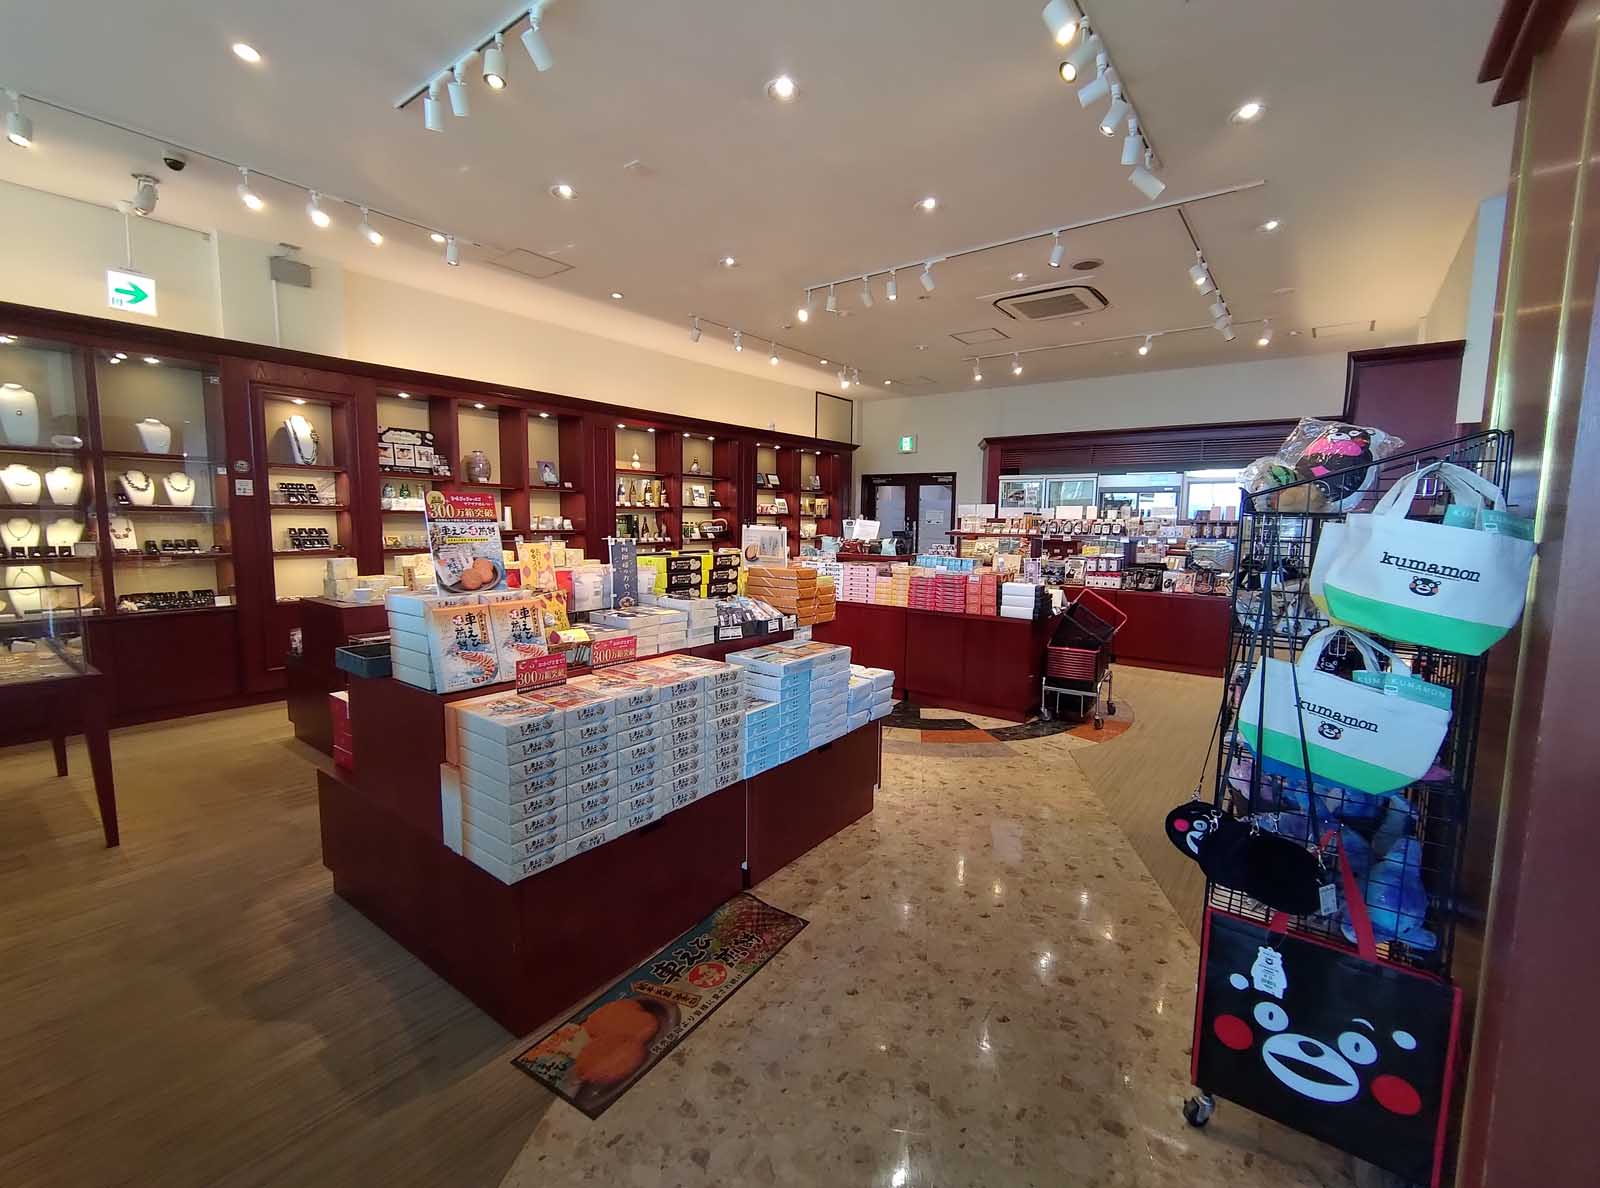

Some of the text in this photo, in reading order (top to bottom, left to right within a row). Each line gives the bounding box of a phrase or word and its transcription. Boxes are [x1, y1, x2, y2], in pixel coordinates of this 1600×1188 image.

[430, 504, 494, 518] 300万箱突破
[1380, 552, 1481, 582] kumamon
[464, 612, 481, 647] 車えび
[519, 606, 533, 639] 車えび
[1294, 696, 1378, 733] kumamon
[650, 933, 713, 984] 車えび
